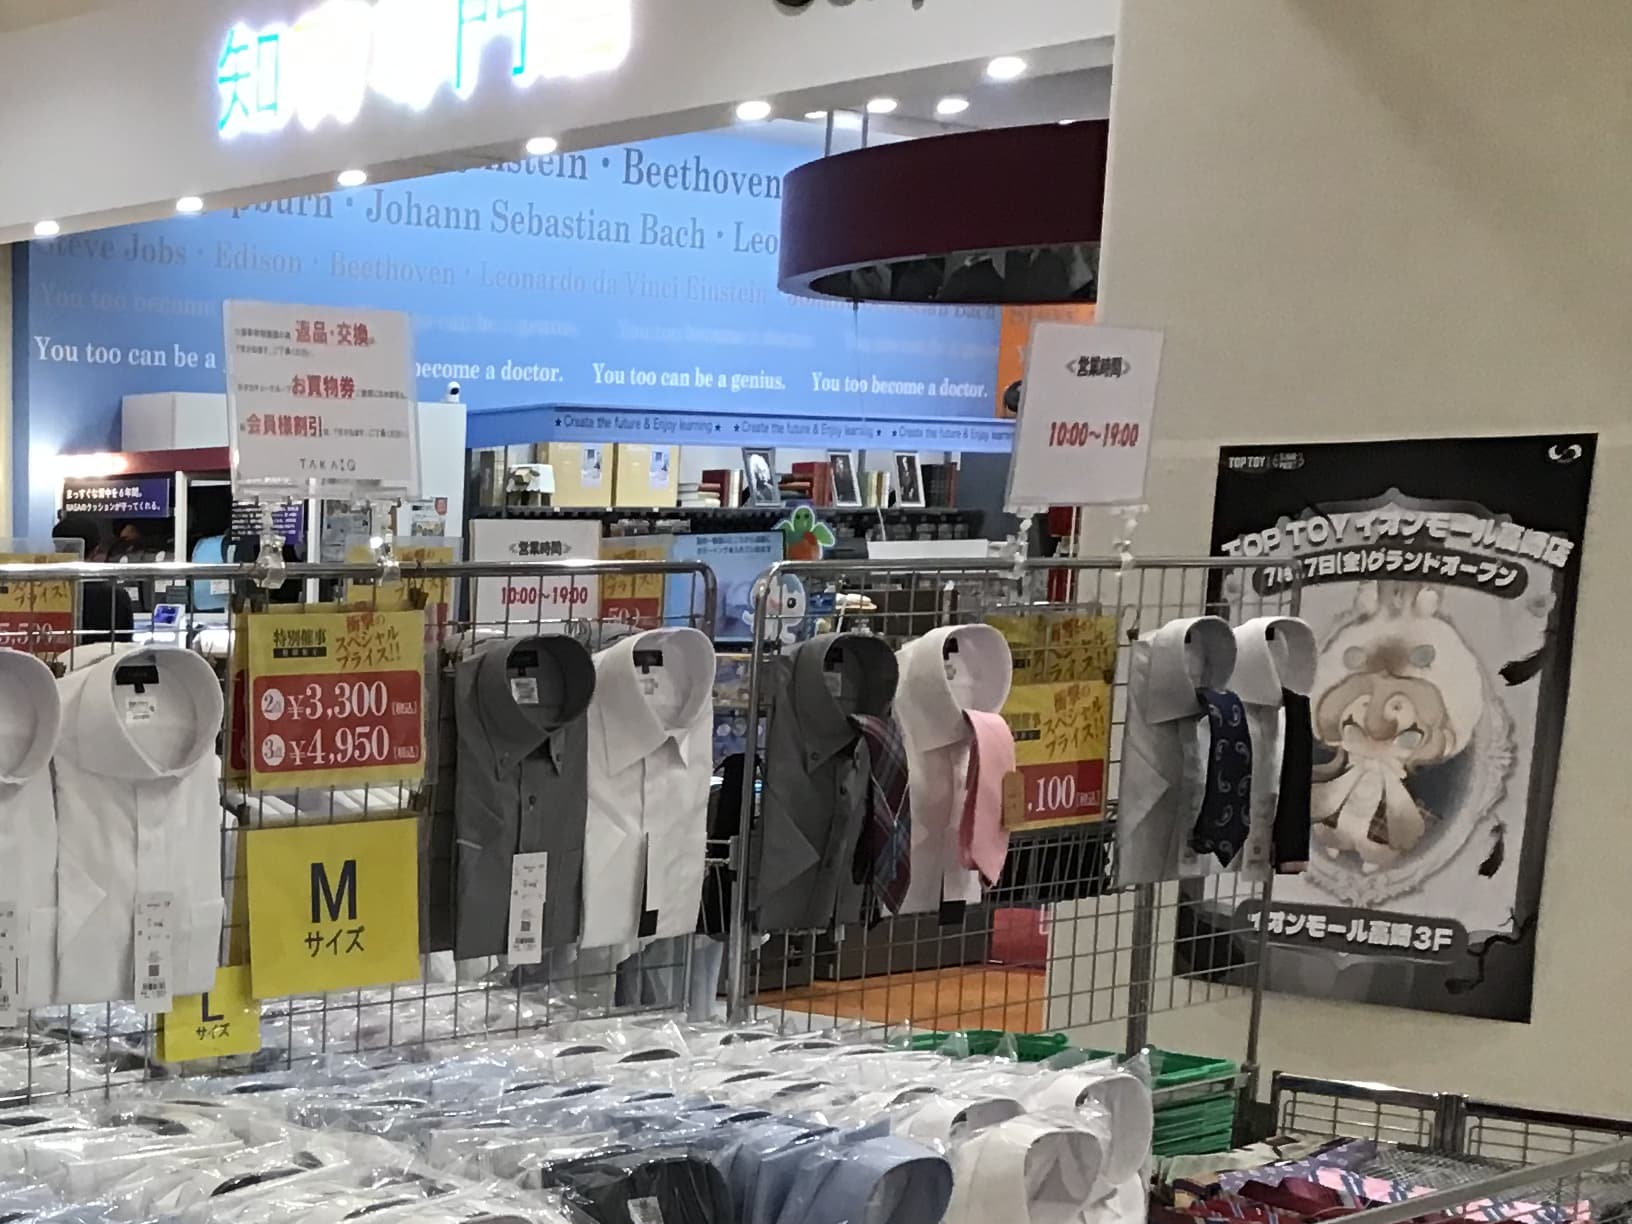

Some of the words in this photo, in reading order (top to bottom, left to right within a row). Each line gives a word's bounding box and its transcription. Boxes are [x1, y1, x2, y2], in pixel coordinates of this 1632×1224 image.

[622, 147, 783, 199] Beethoven
[365, 189, 481, 232] Johann
[490, 199, 631, 245] Sebastian
[639, 213, 706, 250] Bach
[34, 335, 79, 362] You
[86, 343, 122, 365] too
[128, 347, 167, 367] can
[174, 344, 199, 368] be
[205, 350, 217, 369] a
[291, 374, 356, 400] お買物券
[485, 364, 496, 380] a
[592, 362, 625, 385] You
[630, 369, 657, 386] too
[661, 372, 690, 388] can
[695, 366, 714, 388] be
[812, 372, 840, 392] You
[844, 377, 868, 393] too
[871, 374, 925, 395] become
[246, 413, 323, 438] 会員様割引
[1220, 525, 1282, 558] TOP
[1285, 512, 1350, 546] TOY
[335, 626, 400, 652] スペシャル
[287, 680, 389, 721] ¥3,300
[289, 725, 390, 766] ¥4,950
[310, 859, 357, 923] M
[304, 925, 365, 958] サイズ
[201, 991, 224, 1022] L
[195, 1022, 230, 1040] サイズ
